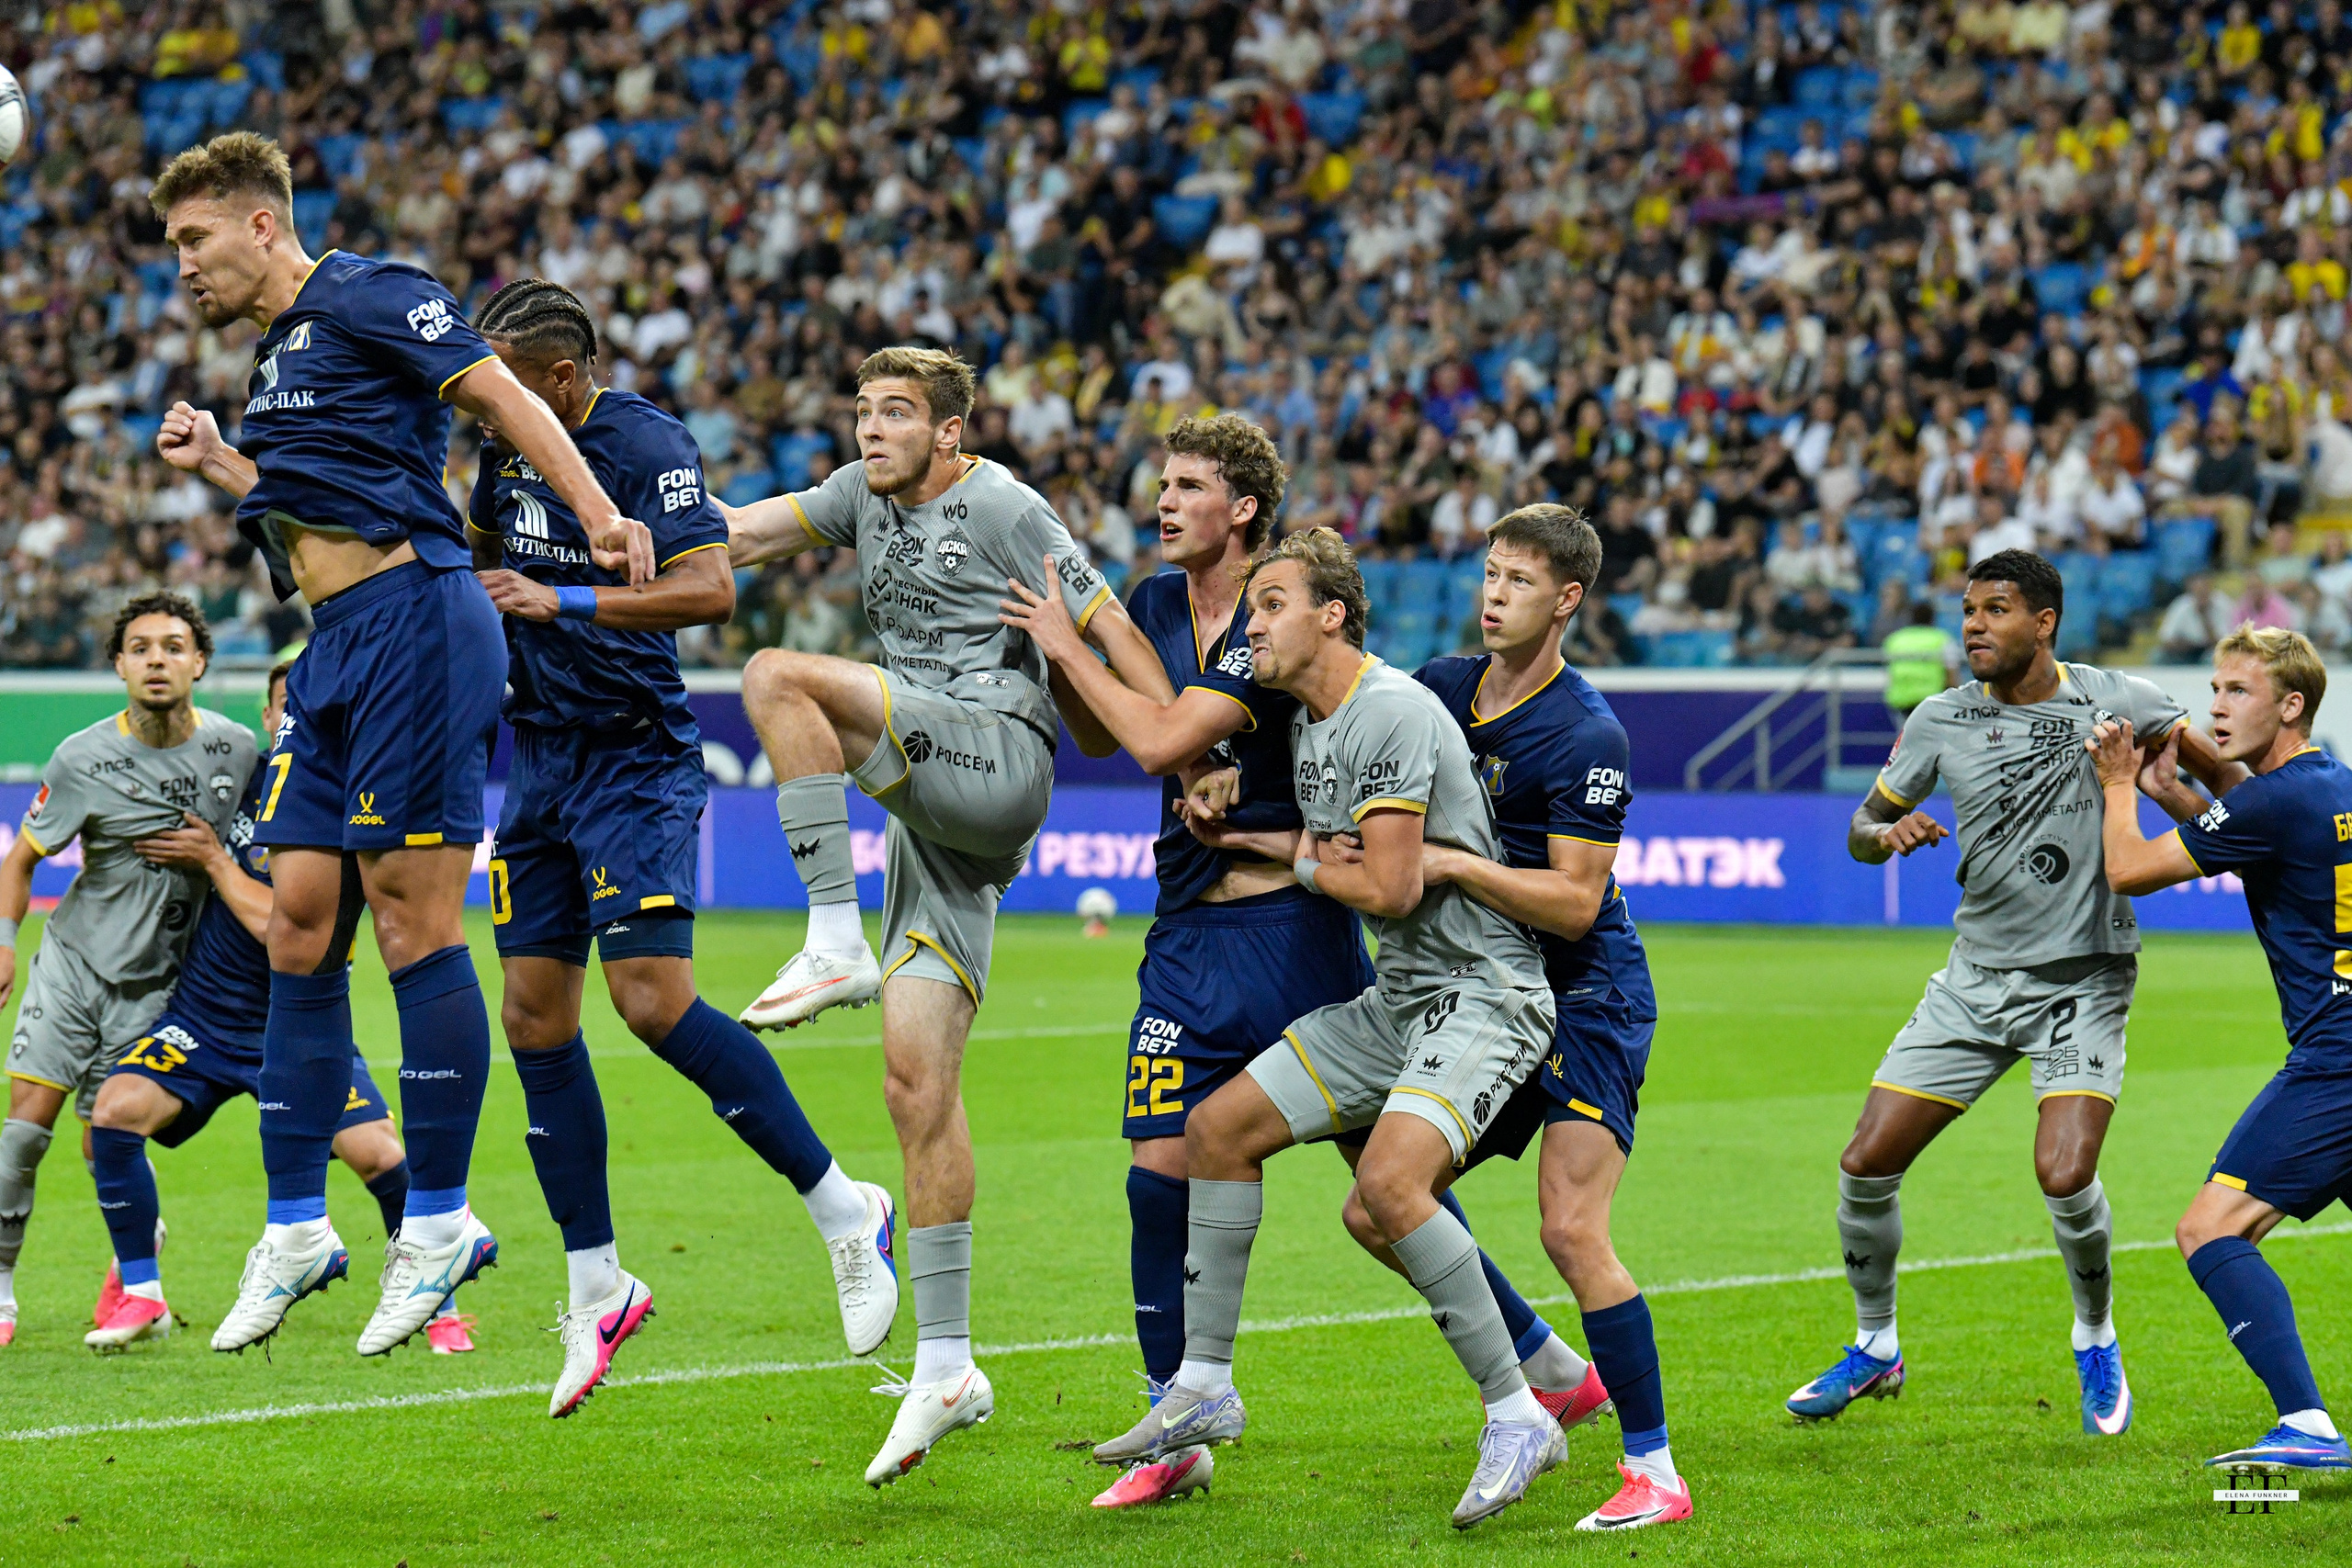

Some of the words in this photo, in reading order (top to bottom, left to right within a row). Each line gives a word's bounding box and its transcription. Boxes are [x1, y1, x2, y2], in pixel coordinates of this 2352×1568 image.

[406, 298, 448, 332] FON
[420, 313, 454, 342] BET
[657, 468, 696, 494] FON
[662, 488, 700, 513] BET
[937, 540, 967, 558] ЦСКА
[894, 577, 939, 598] ЧЕСТНЫЙ
[887, 653, 951, 673] ИМЕТАЛЛ
[1359, 761, 1399, 783] FON
[1586, 767, 1624, 789] FON
[160, 775, 197, 795] FON
[254, 753, 293, 821] 7
[1300, 782, 1319, 804] BET
[1585, 786, 1622, 806] BET
[1611, 836, 1785, 888] ВАТЭК
[1139, 1017, 1183, 1040] FON
[2049, 998, 2077, 1048] 2
[117, 1037, 187, 1072] 13
[1136, 1034, 1178, 1055] BET
[1126, 1055, 1183, 1118] 22
